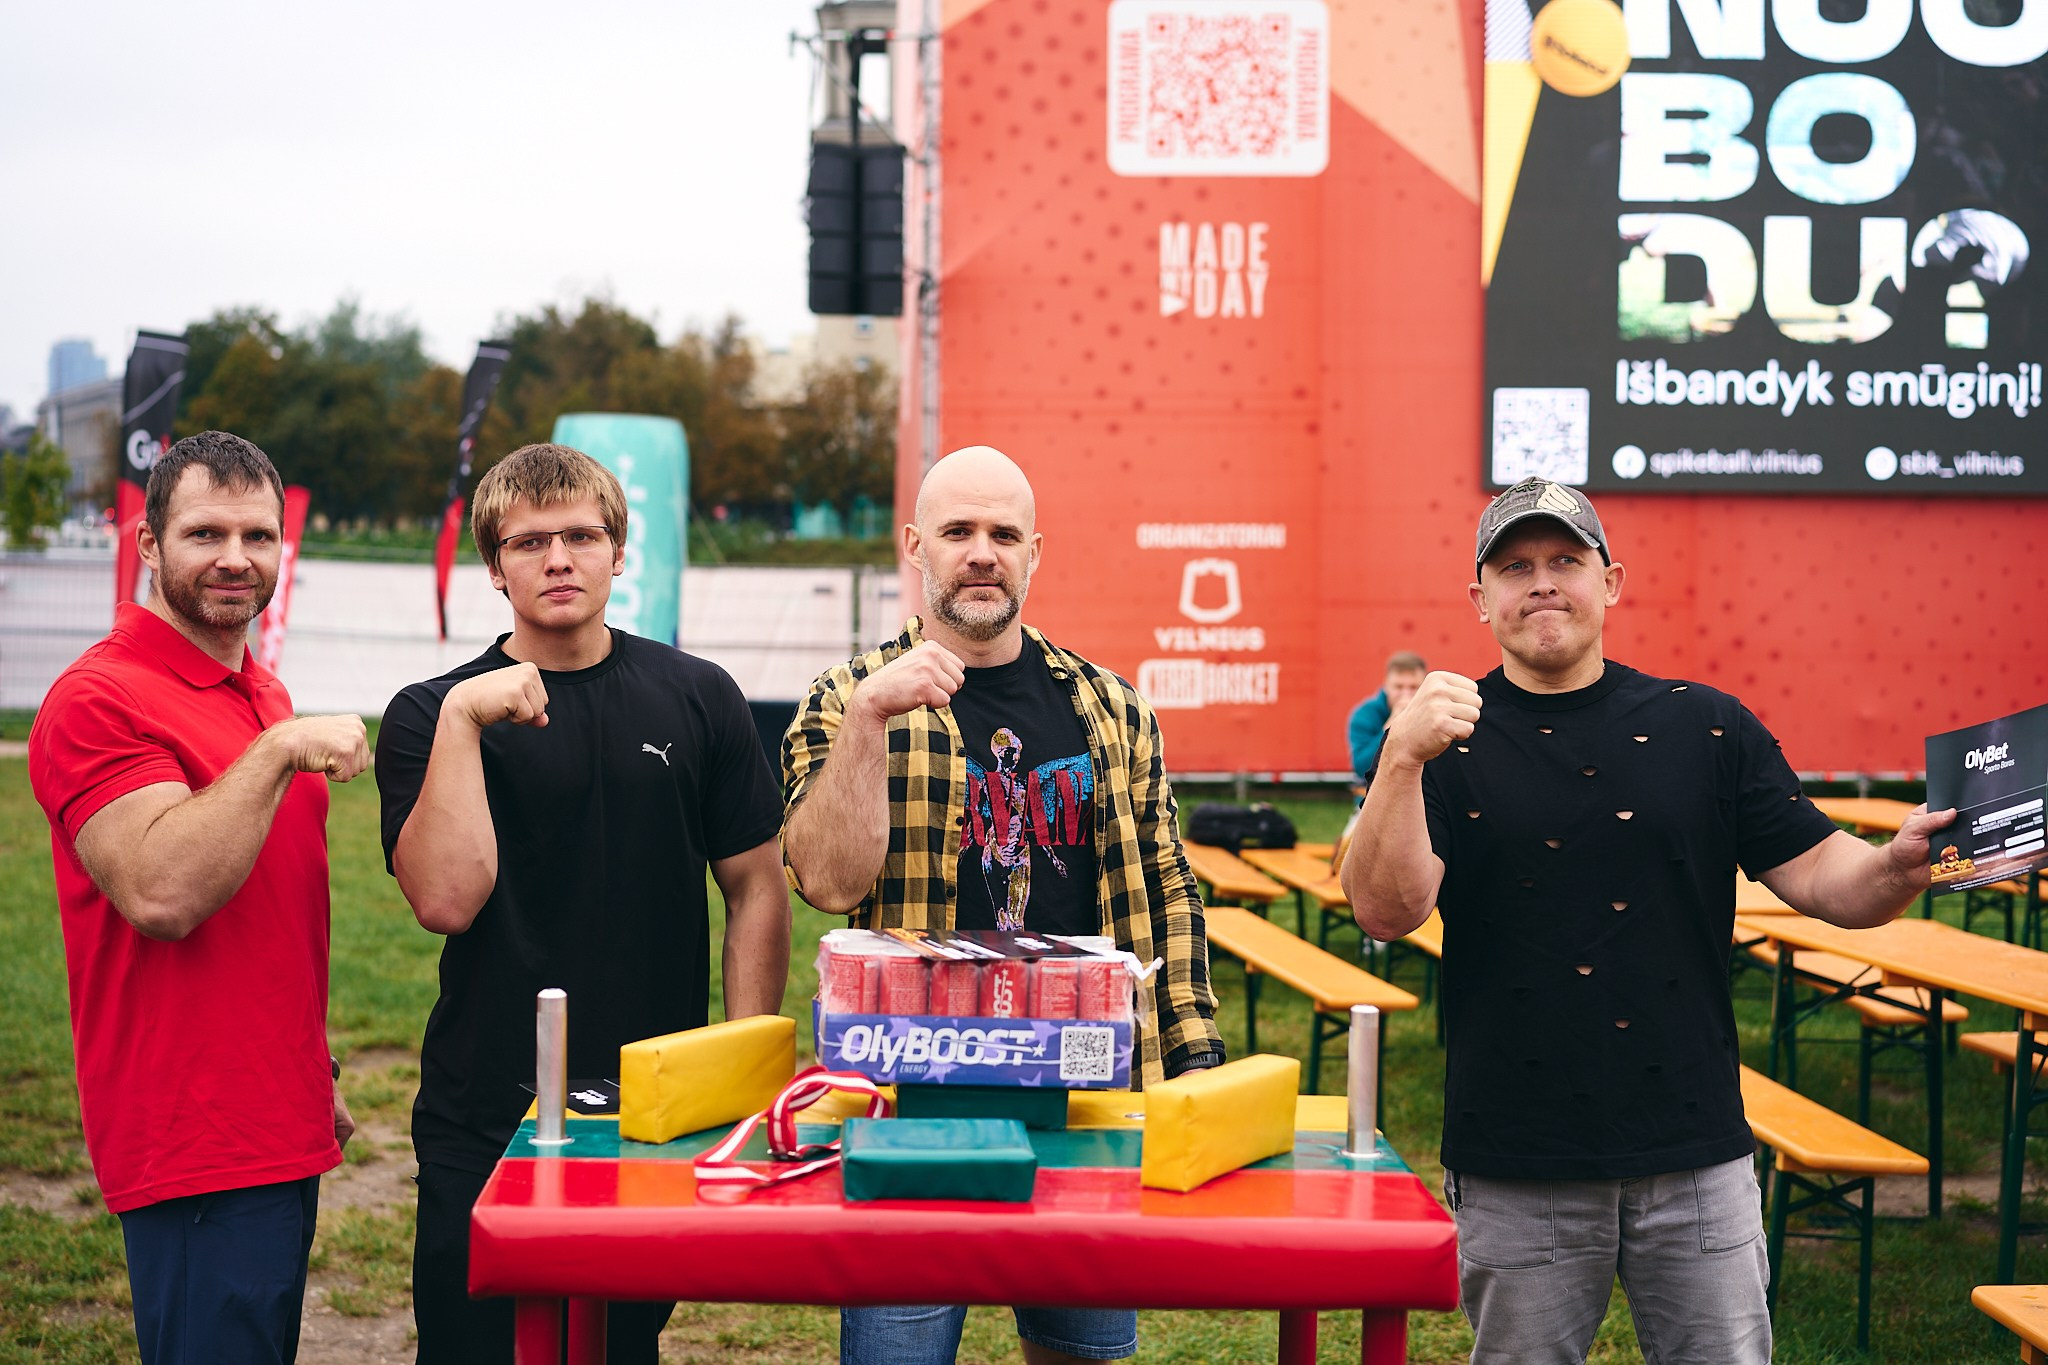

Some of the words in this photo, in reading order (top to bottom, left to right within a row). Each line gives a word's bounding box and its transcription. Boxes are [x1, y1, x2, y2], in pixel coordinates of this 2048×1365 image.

[1618, 71, 1917, 205] BO
[1160, 222, 1268, 270] MADE
[1194, 269, 1267, 318] DAY
[1617, 208, 2030, 350] DU?
[1616, 358, 1834, 418] Išbandyk
[1846, 361, 2042, 419] smūginį!
[1900, 450, 2024, 477] sbk_vilnius
[1155, 627, 1265, 651] VILNIUS
[1965, 742, 2009, 770] OlyBet
[993, 973, 1014, 1018] OST
[841, 1023, 1036, 1073] OlyBOOST
[899, 1063, 929, 1074] ENERGY
